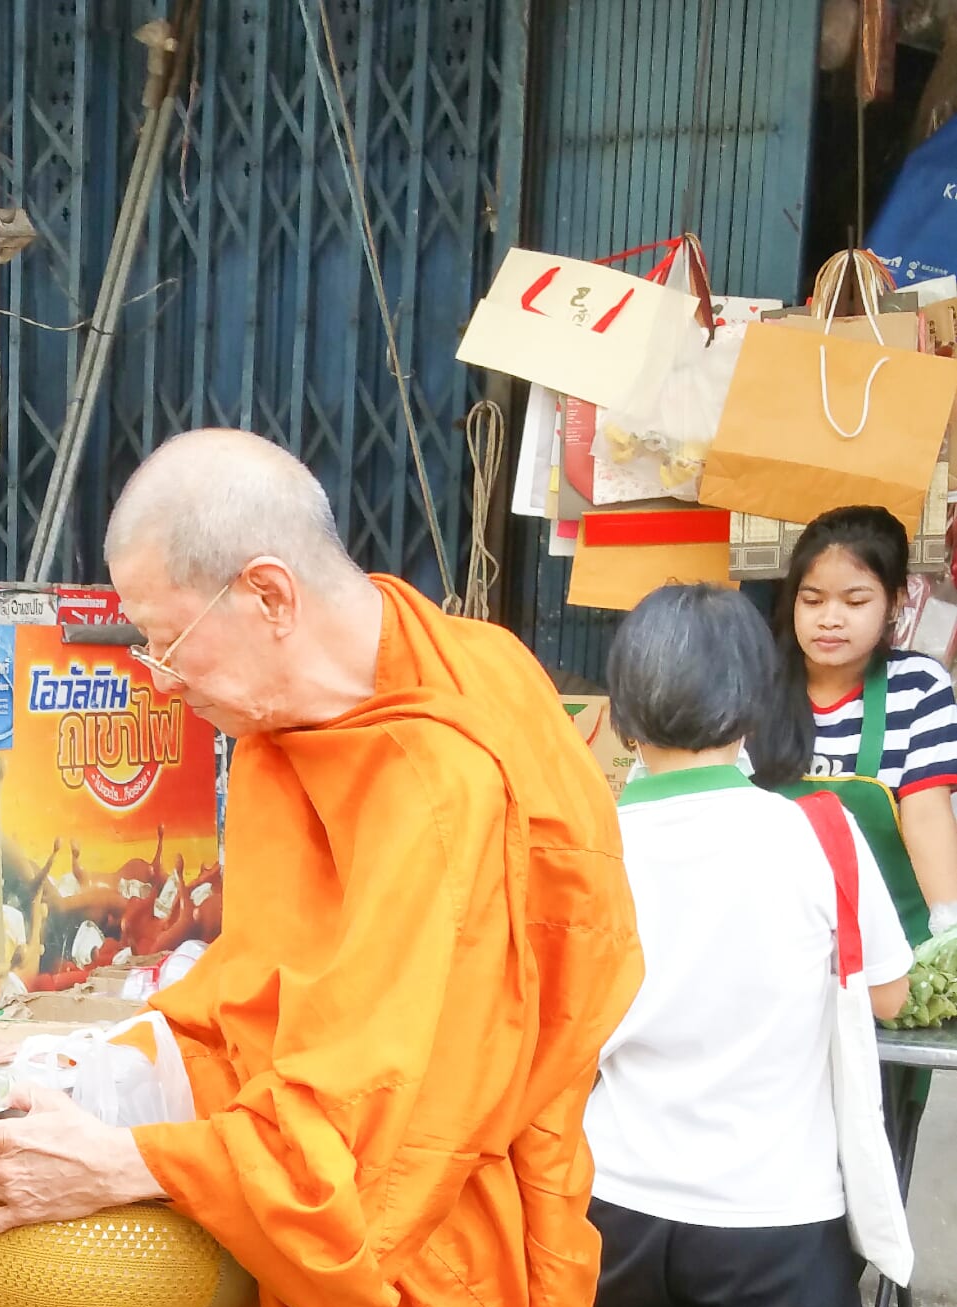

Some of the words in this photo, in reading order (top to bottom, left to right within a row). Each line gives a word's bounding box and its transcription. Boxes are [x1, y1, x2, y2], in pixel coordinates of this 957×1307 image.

[30, 666, 129, 711] โอวัลติน
[58, 687, 182, 789] ภูเขาไฟ
